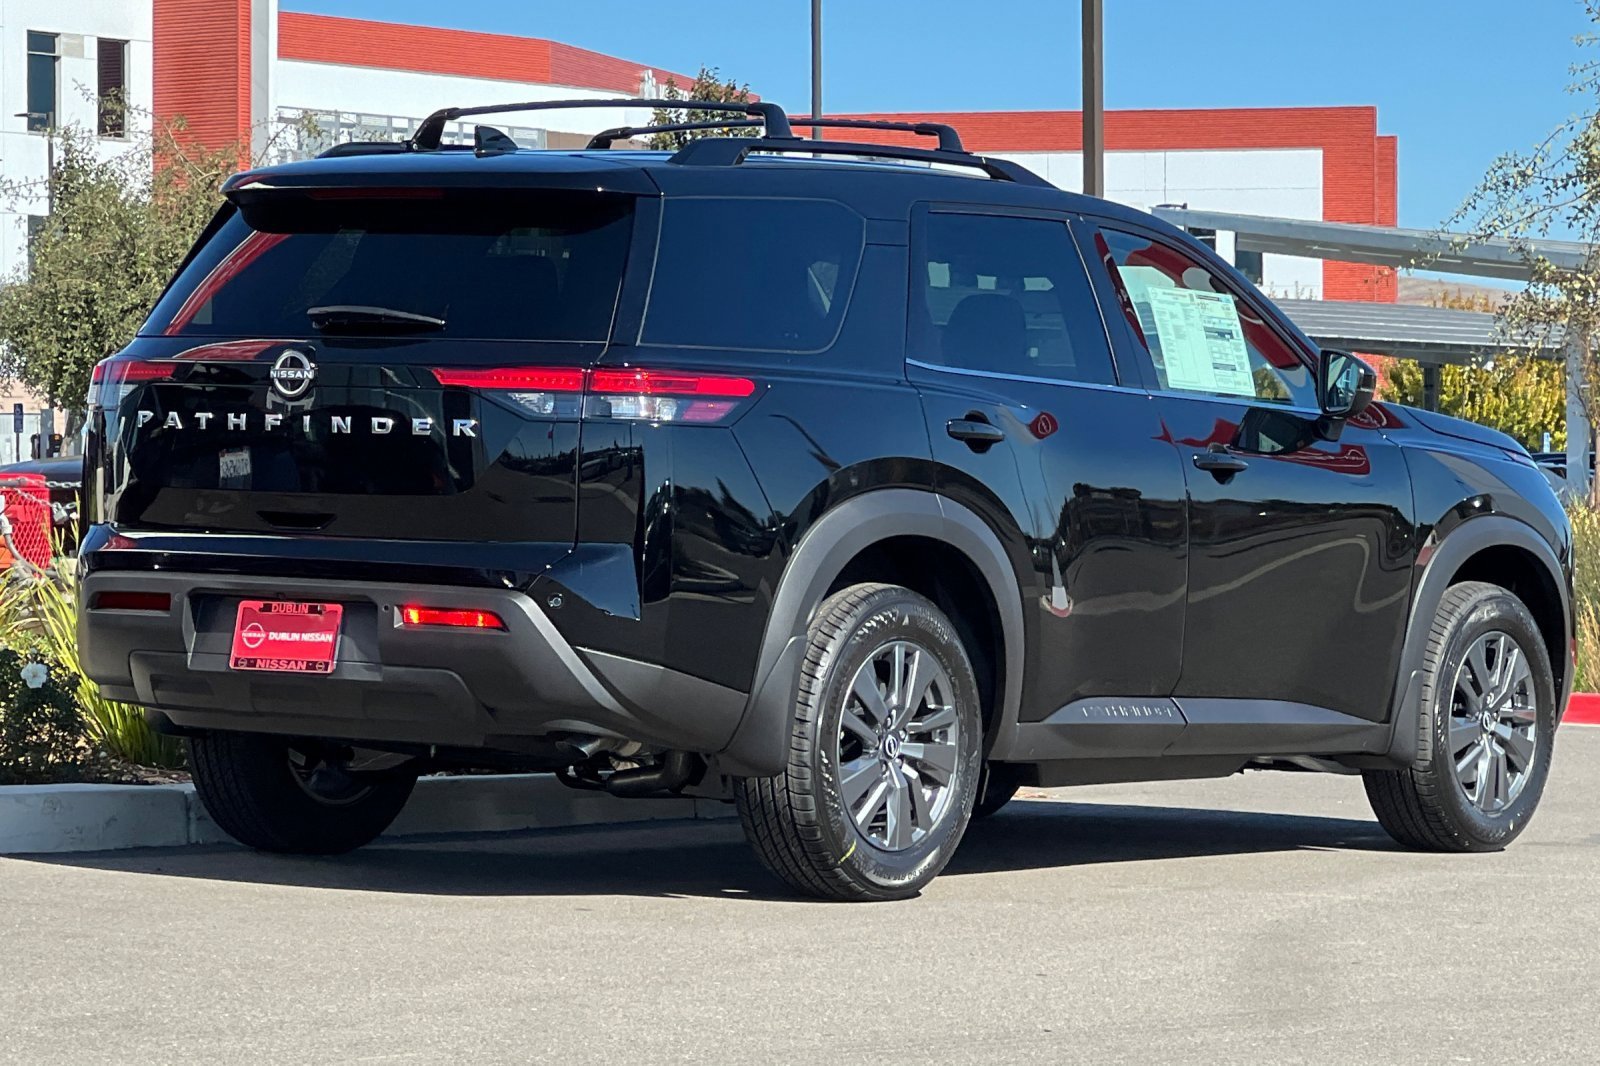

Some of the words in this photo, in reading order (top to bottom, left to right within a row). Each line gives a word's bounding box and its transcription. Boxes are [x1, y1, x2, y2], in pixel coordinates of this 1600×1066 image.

[270, 370, 314, 378] NISSAN
[136, 410, 479, 437] PATHFINDER
[271, 603, 309, 614] DUBLIN
[268, 631, 300, 641] DUBLIN
[301, 632, 333, 643] NISSAN
[255, 658, 307, 670] NISSAN
